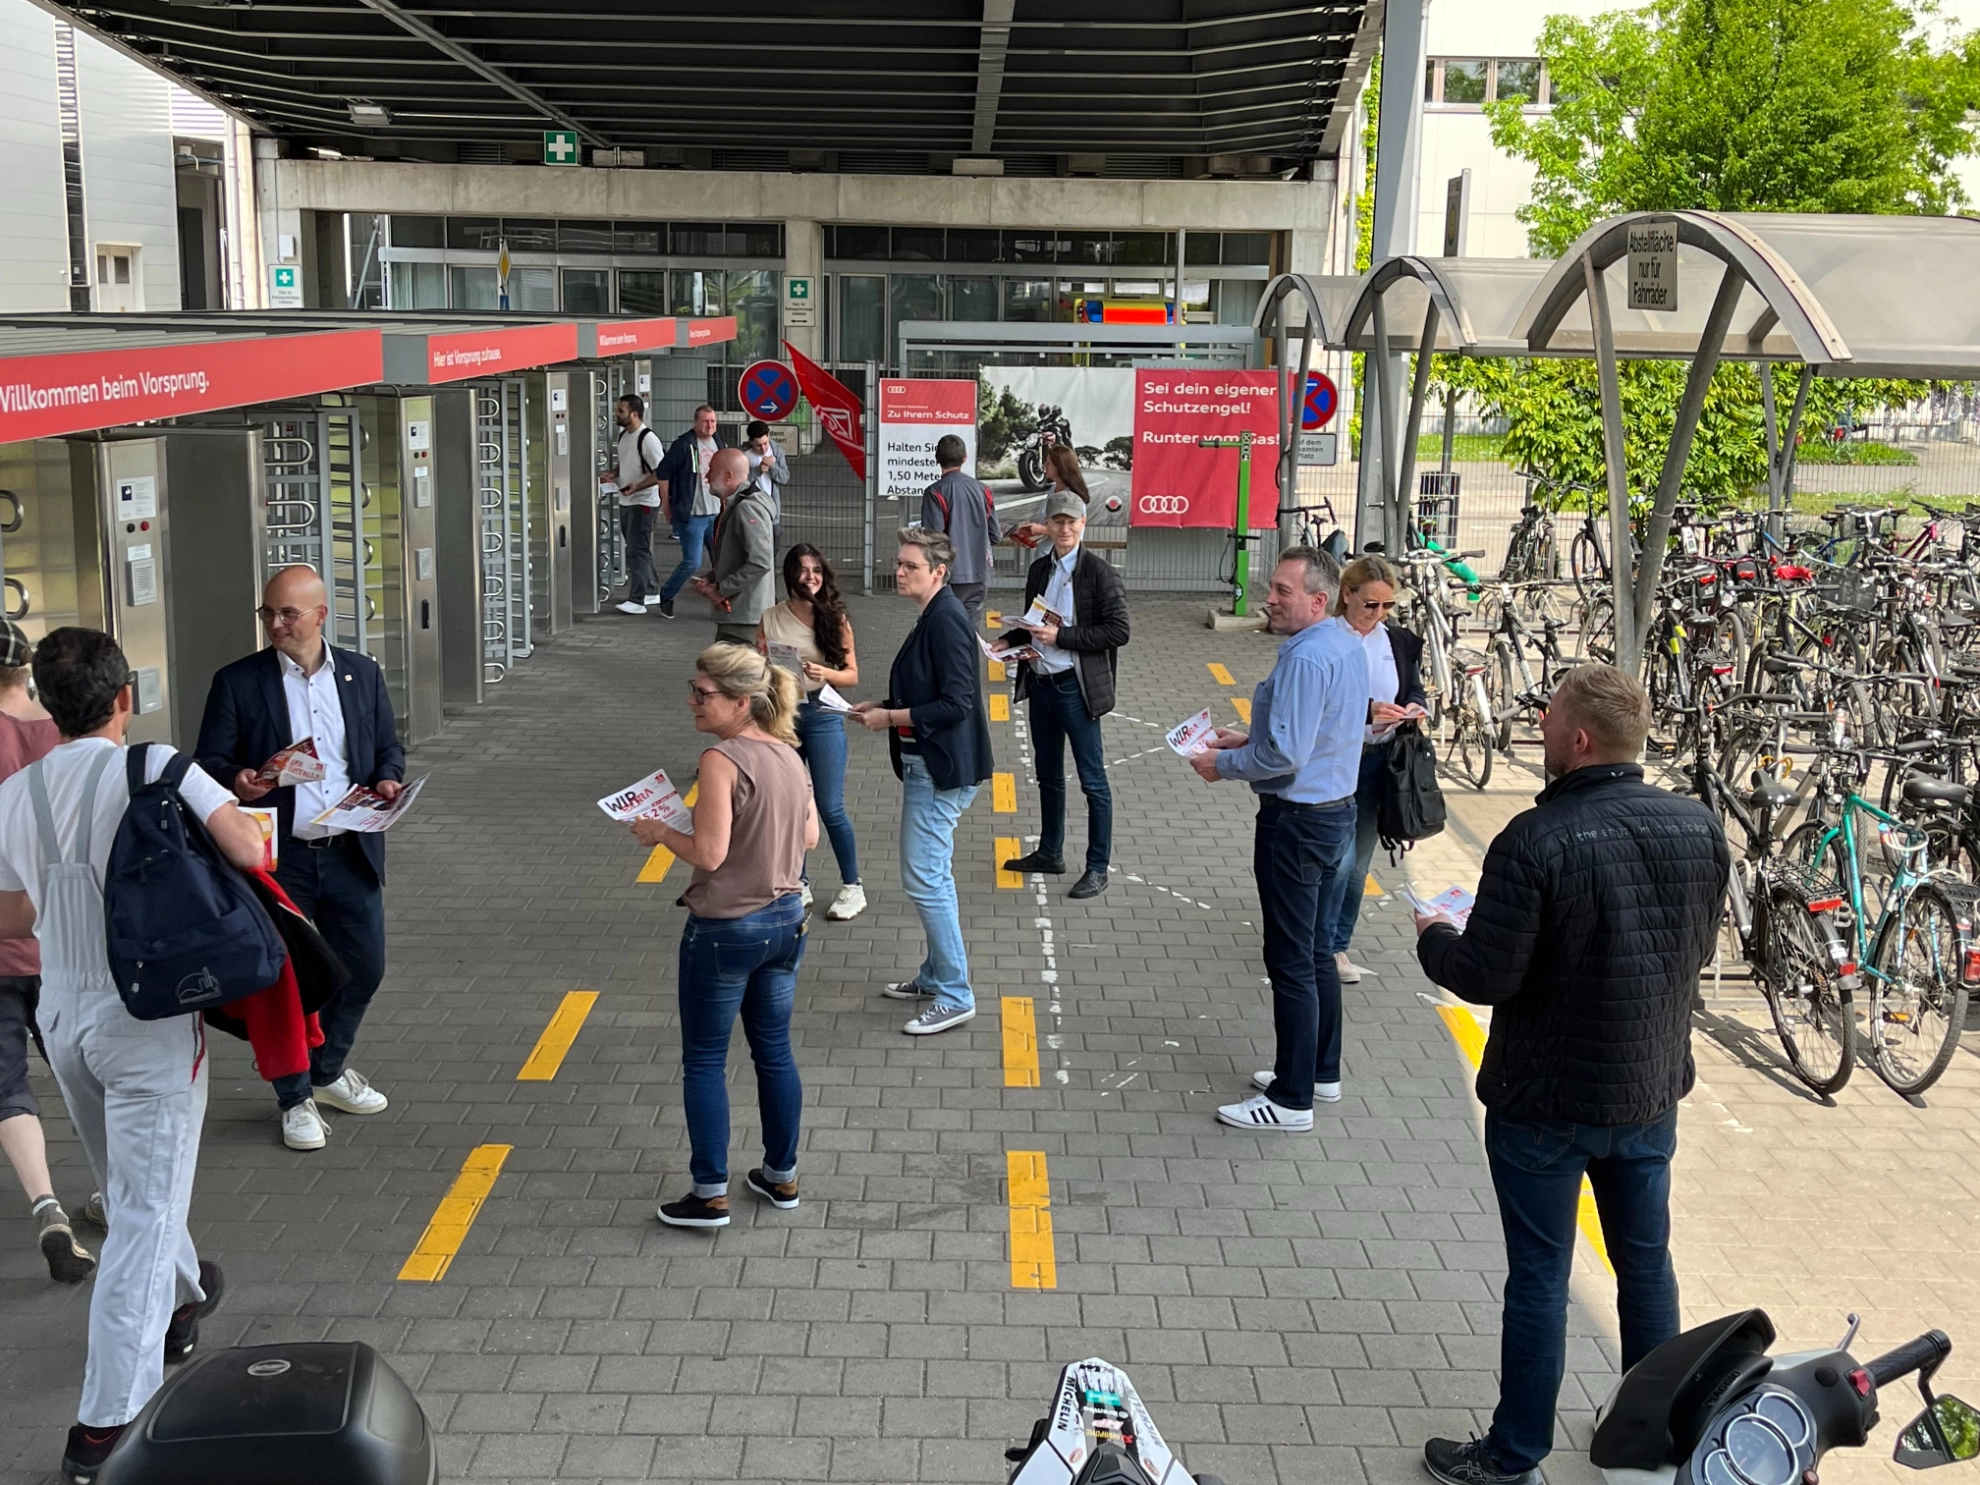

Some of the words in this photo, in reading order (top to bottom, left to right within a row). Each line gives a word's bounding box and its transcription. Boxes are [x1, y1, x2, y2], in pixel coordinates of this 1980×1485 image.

[1629, 230, 1673, 253] Abstellfläche
[1639, 262, 1650, 278] nur
[1651, 256, 1661, 278] für
[1633, 282, 1668, 305] Fahrräder
[433, 351, 446, 367] Hier
[446, 350, 454, 366] ist
[454, 349, 481, 368] Vorsprung
[481, 346, 502, 362] zuhause.
[102, 374, 138, 400] beim
[139, 371, 209, 398] Vorsprung.
[1144, 382, 1169, 395] Sei
[1174, 383, 1209, 396] dein
[1214, 384, 1277, 398] eigener
[887, 410, 901, 418] Zu
[903, 410, 933, 418] Ihrem
[935, 411, 970, 419] Schutz
[1144, 401, 1251, 417] Schutzengel!
[1143, 432, 1199, 445] Runter
[1203, 434, 1240, 443] vom
[887, 442, 922, 452] Halten
[887, 457, 939, 467] mindeste
[888, 470, 911, 482] 1,50
[887, 485, 925, 495] Abstan
[1168, 724, 1191, 748] WIR
[604, 791, 637, 813] WIR
[1576, 829, 1597, 842] the
[1057, 1375, 1076, 1432] MICHELIN
